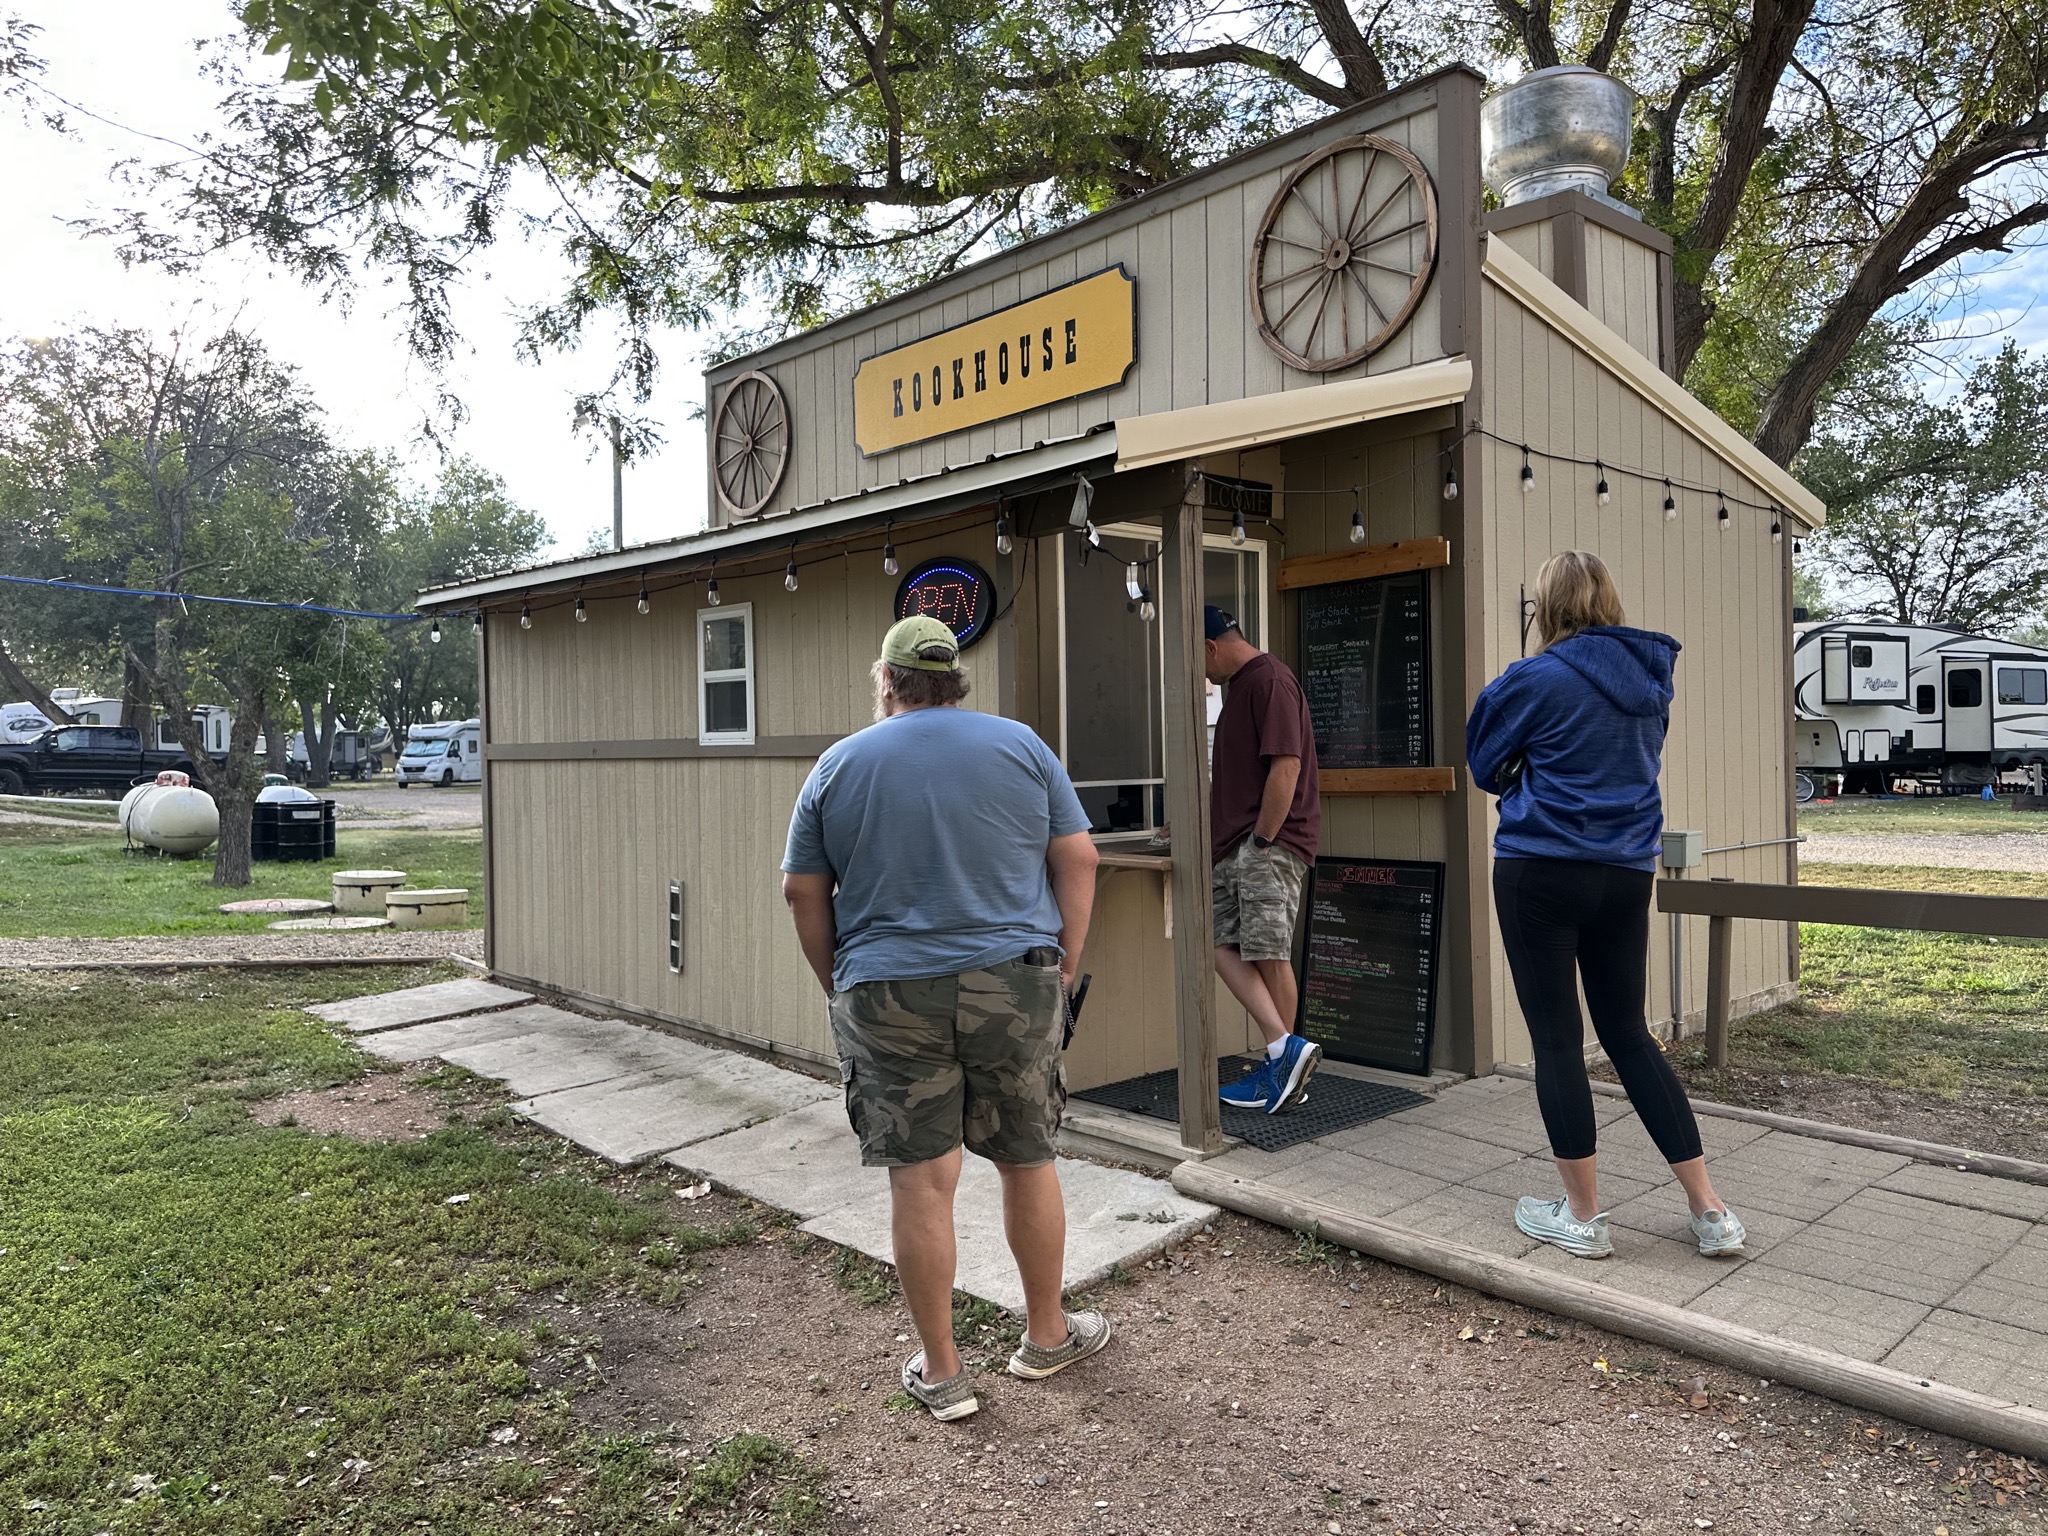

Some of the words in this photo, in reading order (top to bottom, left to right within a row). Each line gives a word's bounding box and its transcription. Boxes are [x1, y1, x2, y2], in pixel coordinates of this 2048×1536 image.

[893, 318, 1077, 418] KOOKHOUSE
[1207, 482, 1268, 513] LCOME
[1306, 608, 1326, 620] Short
[1327, 604, 1350, 617] Stack
[1306, 620, 1320, 631] Full
[1311, 709, 1335, 718] crambled
[1336, 865, 1397, 886] DINNER
[1564, 1222, 1596, 1238] HOKA
